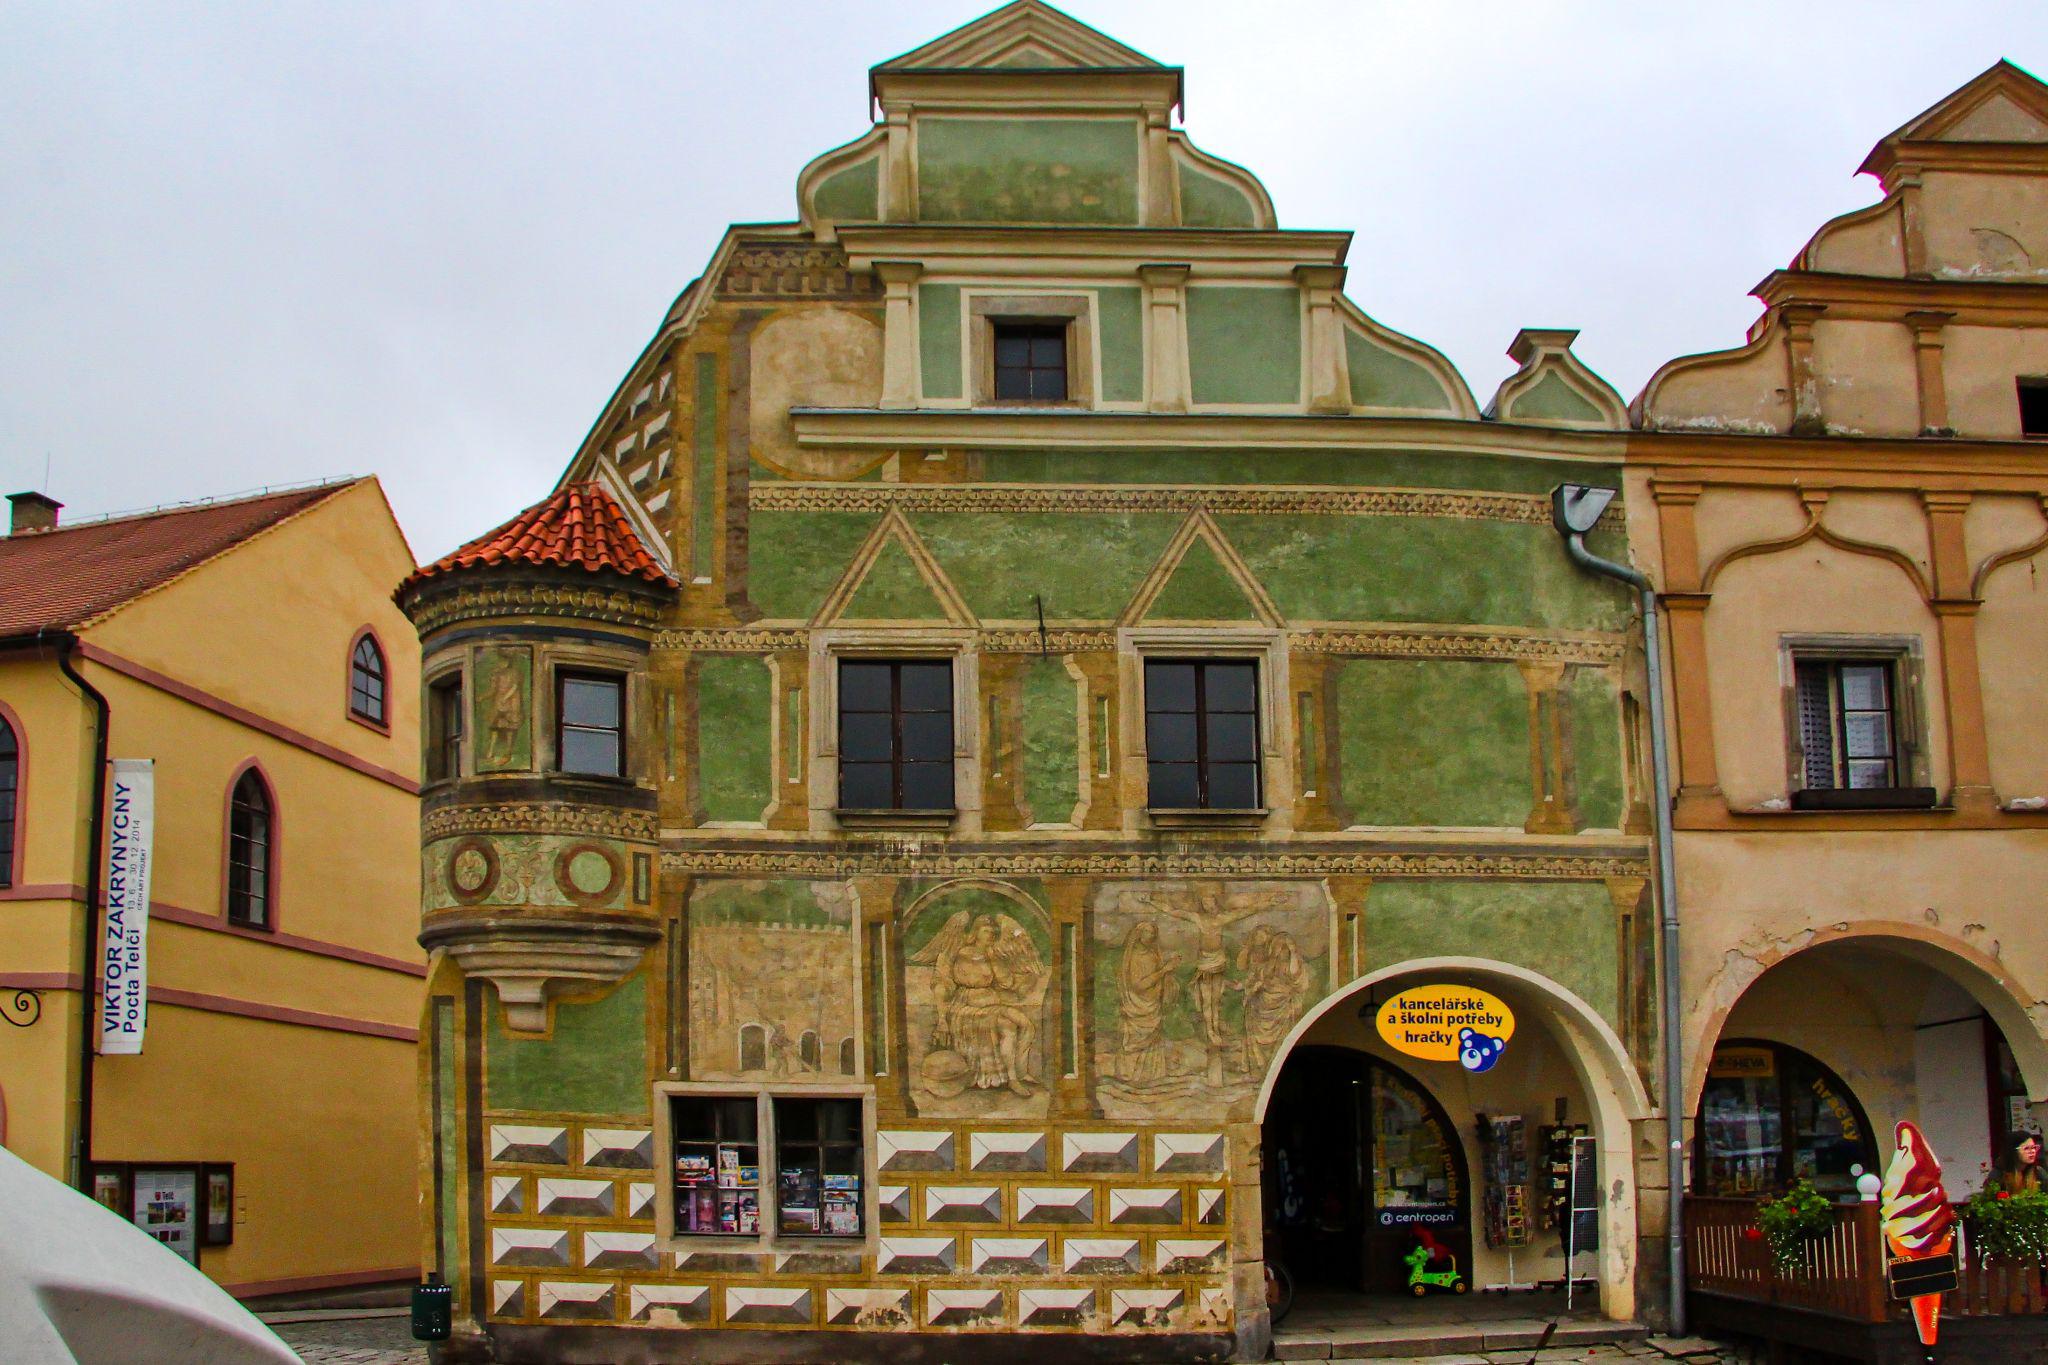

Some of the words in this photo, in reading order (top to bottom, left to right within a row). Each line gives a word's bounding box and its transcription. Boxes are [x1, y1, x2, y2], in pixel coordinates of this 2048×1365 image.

[131, 819, 140, 842] 2014
[108, 782, 130, 939] ZAKRYNYCNY
[124, 929, 139, 972] Telči
[104, 947, 122, 1033] VIKTOR
[122, 979, 139, 1033] Pocta
[1399, 998, 1484, 1010] kancelářské
[1388, 1015, 1396, 1024] a
[1401, 1012, 1443, 1024] školní
[1447, 1012, 1503, 1028] potřeby
[1405, 1031, 1453, 1046] hračky
[1395, 1213, 1454, 1223] centropen
